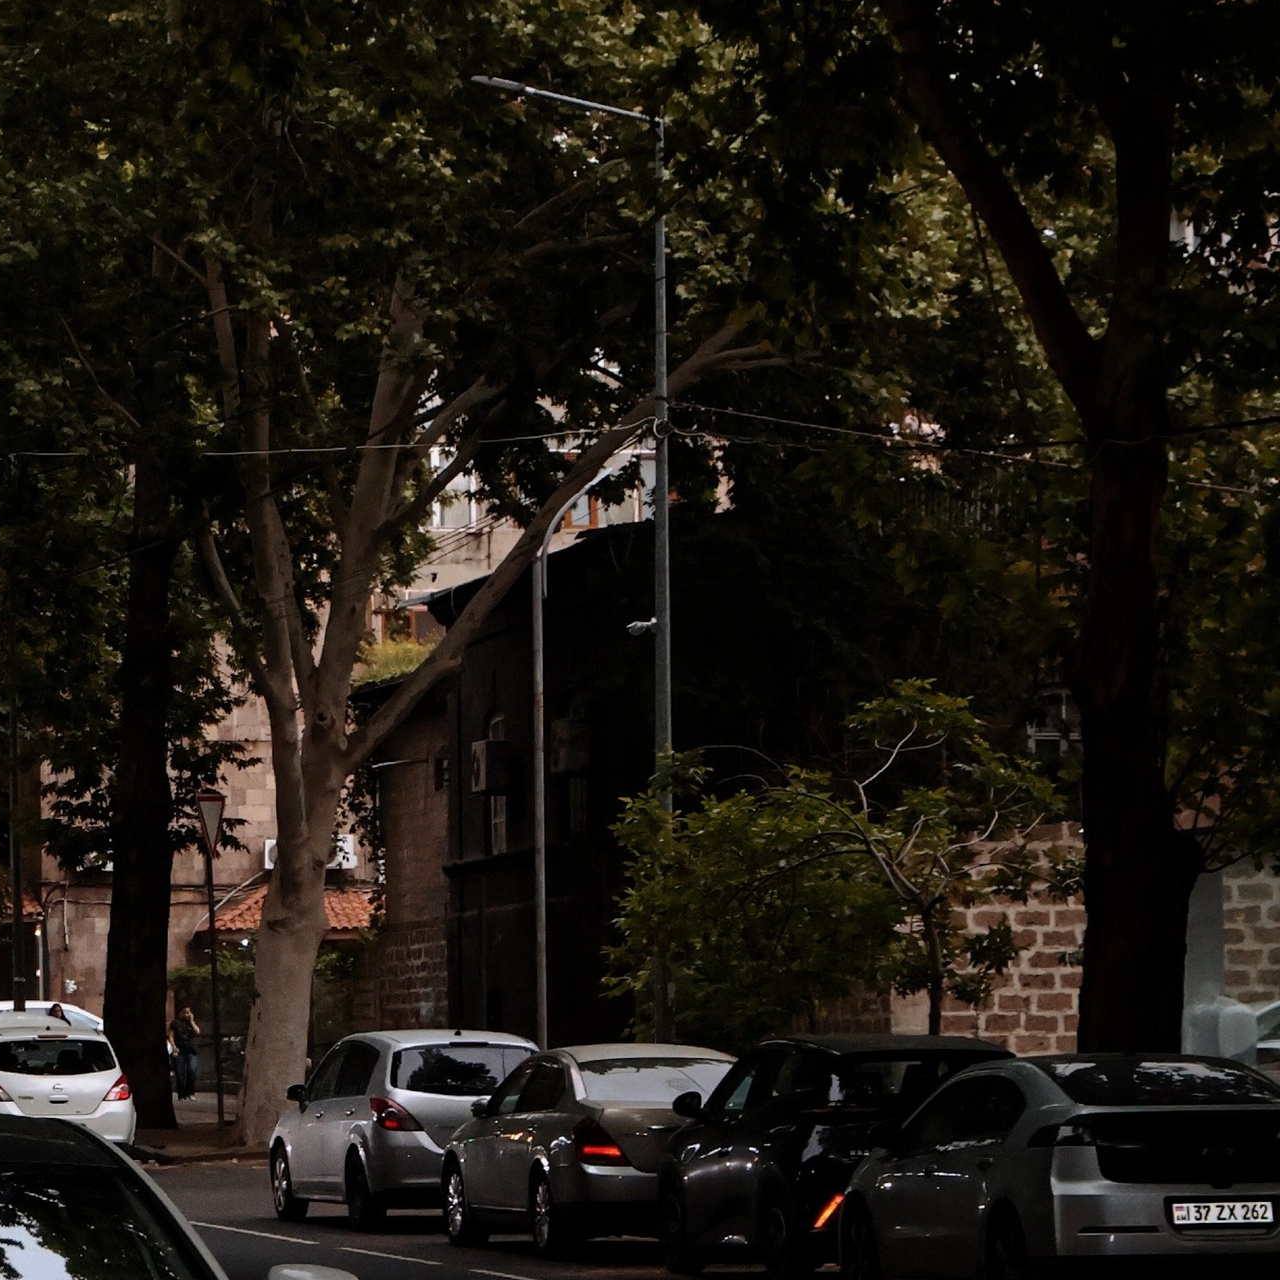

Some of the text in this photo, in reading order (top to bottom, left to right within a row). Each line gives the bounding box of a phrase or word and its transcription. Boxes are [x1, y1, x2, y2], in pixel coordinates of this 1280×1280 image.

[1193, 1205, 1211, 1221] 37
[1215, 1205, 1238, 1221] ZX
[1241, 1204, 1269, 1220] 262
